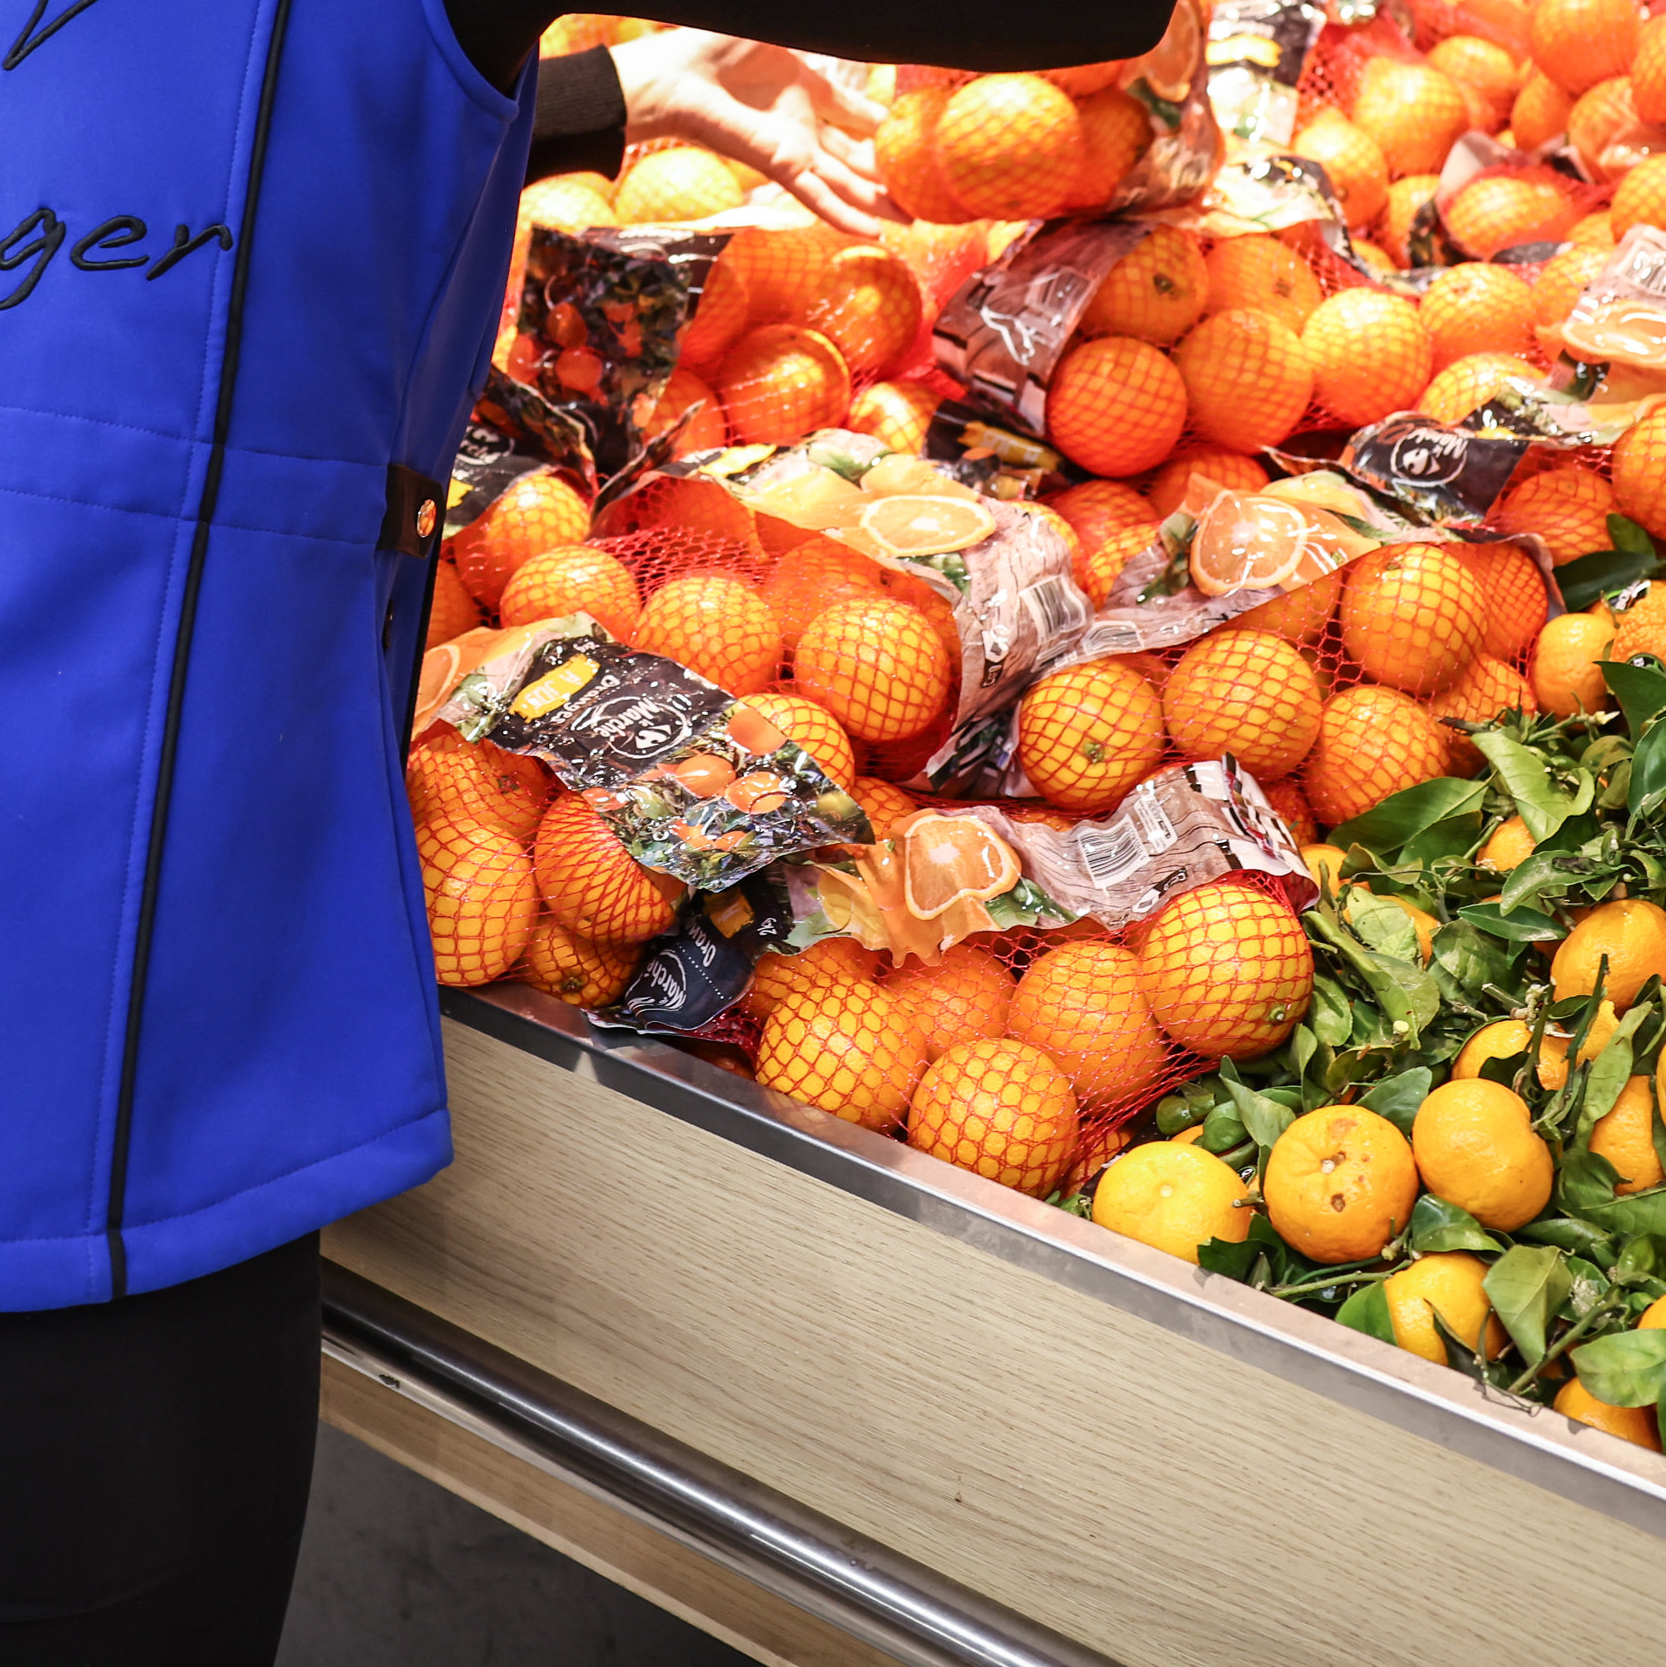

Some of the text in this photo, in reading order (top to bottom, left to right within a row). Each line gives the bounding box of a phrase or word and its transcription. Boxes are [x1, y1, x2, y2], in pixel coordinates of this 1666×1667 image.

[549, 674, 622, 726] Oranges
[592, 697, 662, 741] Marché
[756, 917, 777, 937] 2kg
